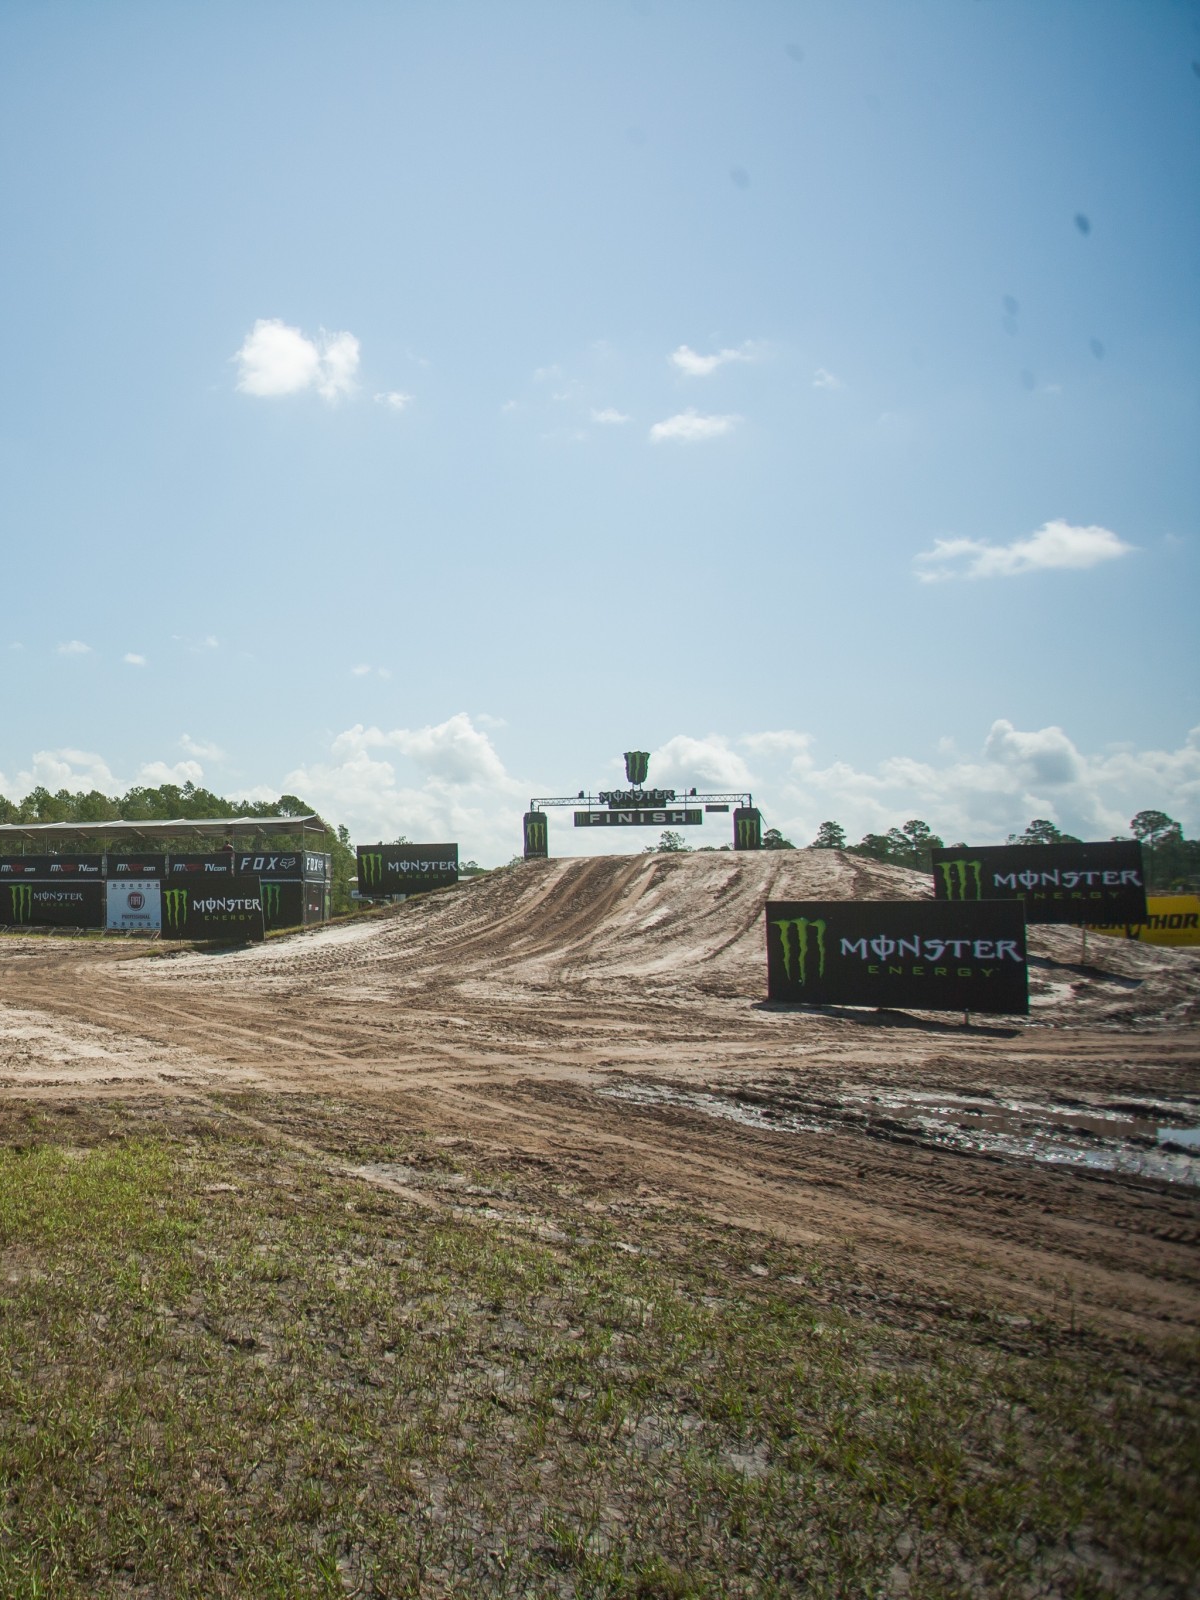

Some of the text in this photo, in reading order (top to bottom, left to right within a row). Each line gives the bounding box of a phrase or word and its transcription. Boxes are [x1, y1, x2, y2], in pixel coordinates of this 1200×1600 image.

[600, 790, 674, 802] MONSTER
[590, 812, 686, 823] FINISH
[240, 857, 278, 870] FOX
[306, 857, 318, 871] FOX
[388, 860, 457, 872] MONSTER
[993, 869, 1142, 889] MONSTER
[33, 892, 83, 901] MONSTER
[193, 897, 262, 913] MONSTER
[1147, 913, 1198, 929] THOR
[840, 934, 1024, 962] MONSTER
[868, 965, 995, 977] ENERGY
